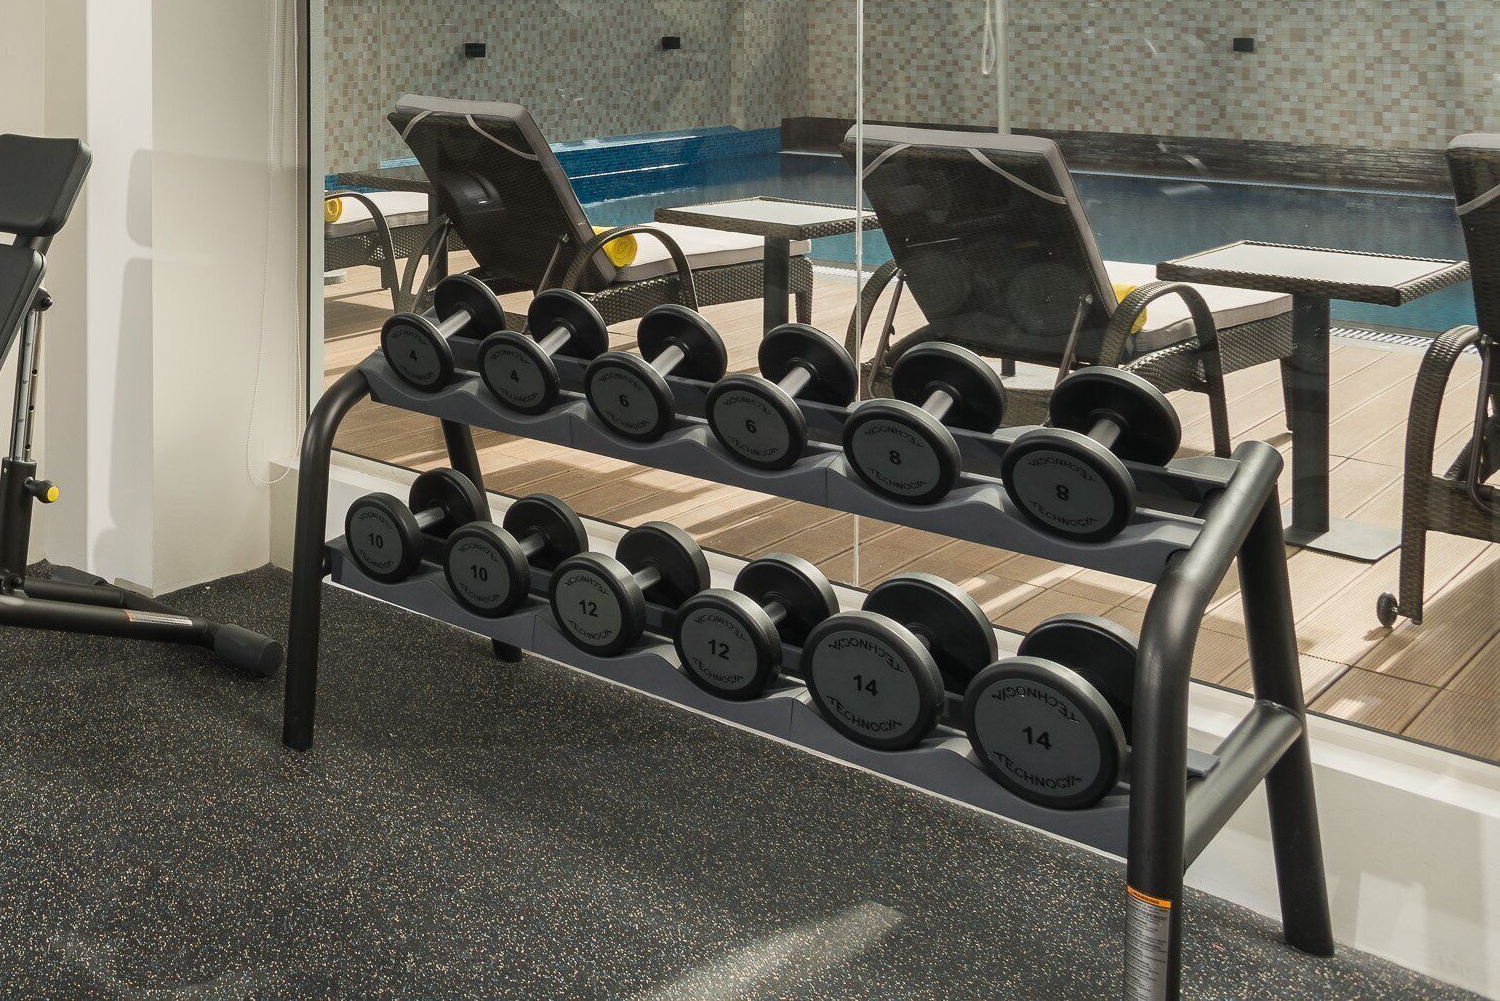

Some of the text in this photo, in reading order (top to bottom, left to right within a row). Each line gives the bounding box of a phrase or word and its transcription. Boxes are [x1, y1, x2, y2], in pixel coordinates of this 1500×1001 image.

[409, 349, 418, 362] 4
[510, 370, 520, 383] 4
[619, 394, 630, 408] 6
[745, 419, 757, 434] 6
[889, 449, 902, 465] 8
[1055, 484, 1070, 501] 8
[368, 532, 383, 549] 10
[470, 564, 488, 582] 10
[579, 599, 598, 618] 12
[708, 639, 730, 661] 12
[853, 674, 878, 696] 14
[1022, 726, 1052, 750] 14
